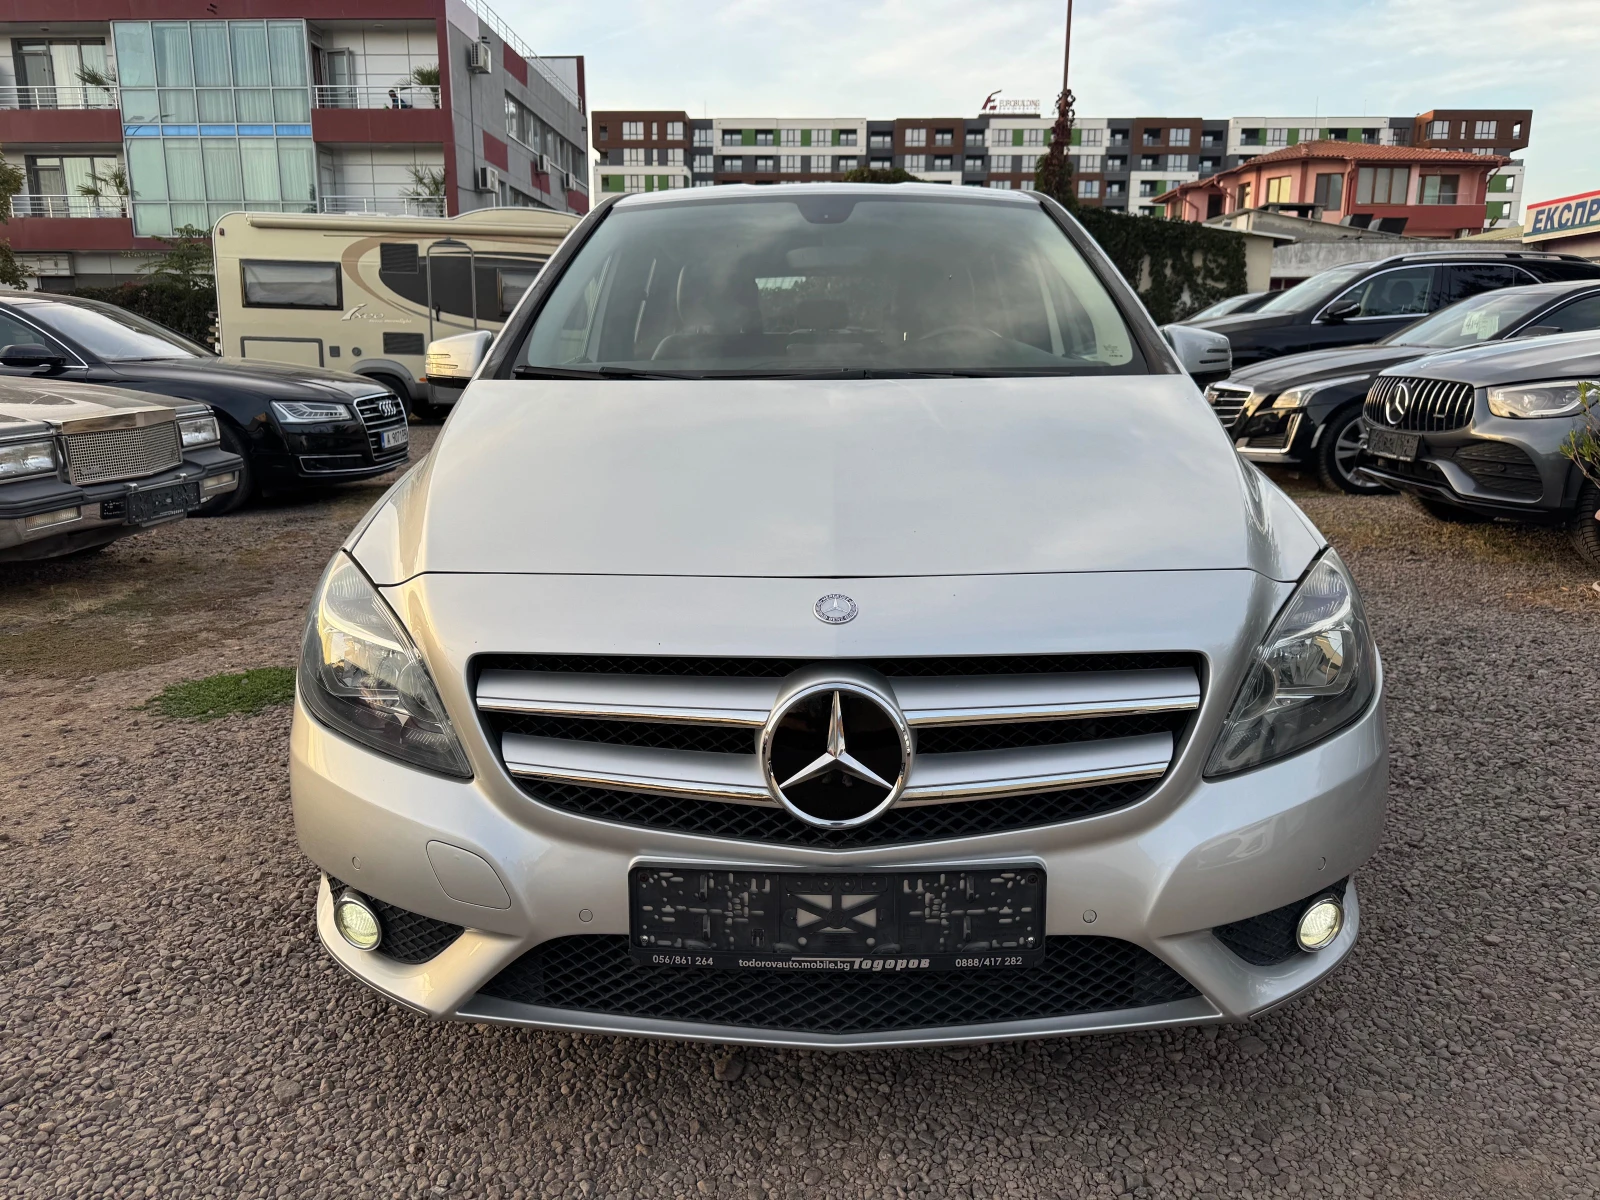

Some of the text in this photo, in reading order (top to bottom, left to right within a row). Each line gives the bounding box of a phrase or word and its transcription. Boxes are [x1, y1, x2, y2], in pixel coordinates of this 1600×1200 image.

[652, 954, 714, 966] 056/861 264
[738, 958, 850, 971] todorovauto.mobile.bg
[955, 956, 1023, 968] 0888/417 282
